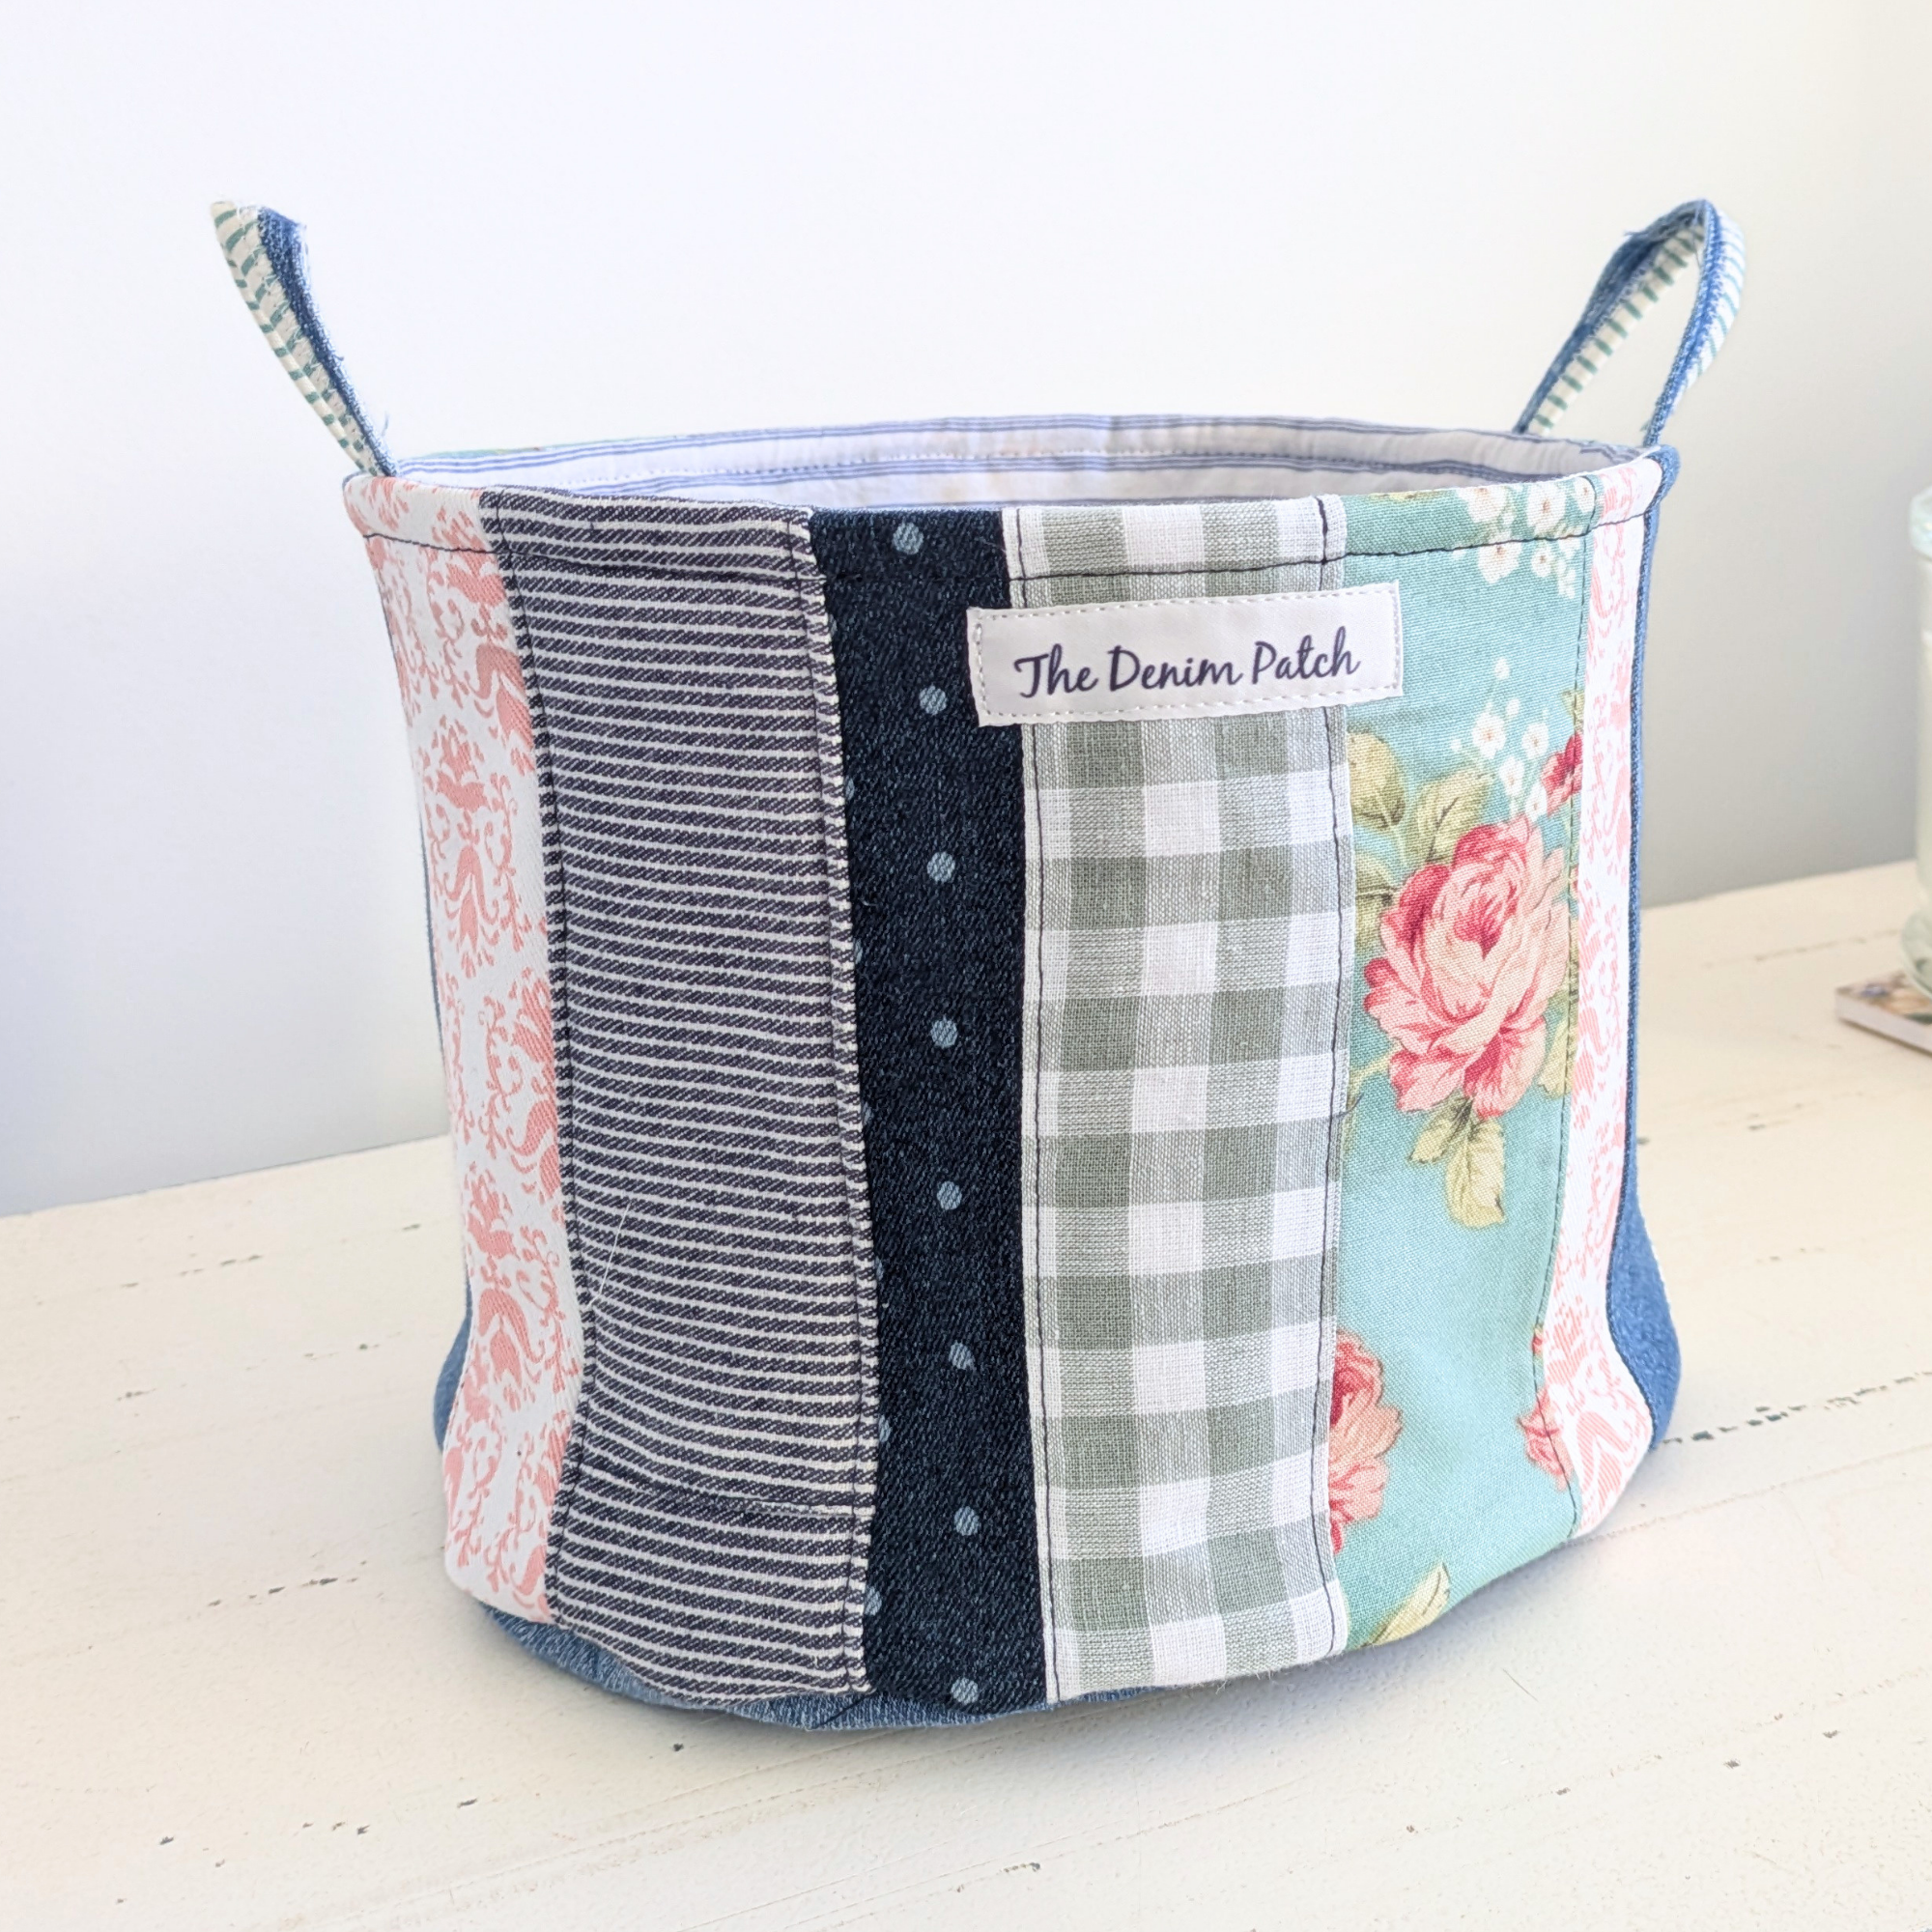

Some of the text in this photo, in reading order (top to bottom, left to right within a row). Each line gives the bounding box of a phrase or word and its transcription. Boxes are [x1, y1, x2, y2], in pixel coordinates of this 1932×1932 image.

[1013, 626, 1361, 698] The Denim Patch
